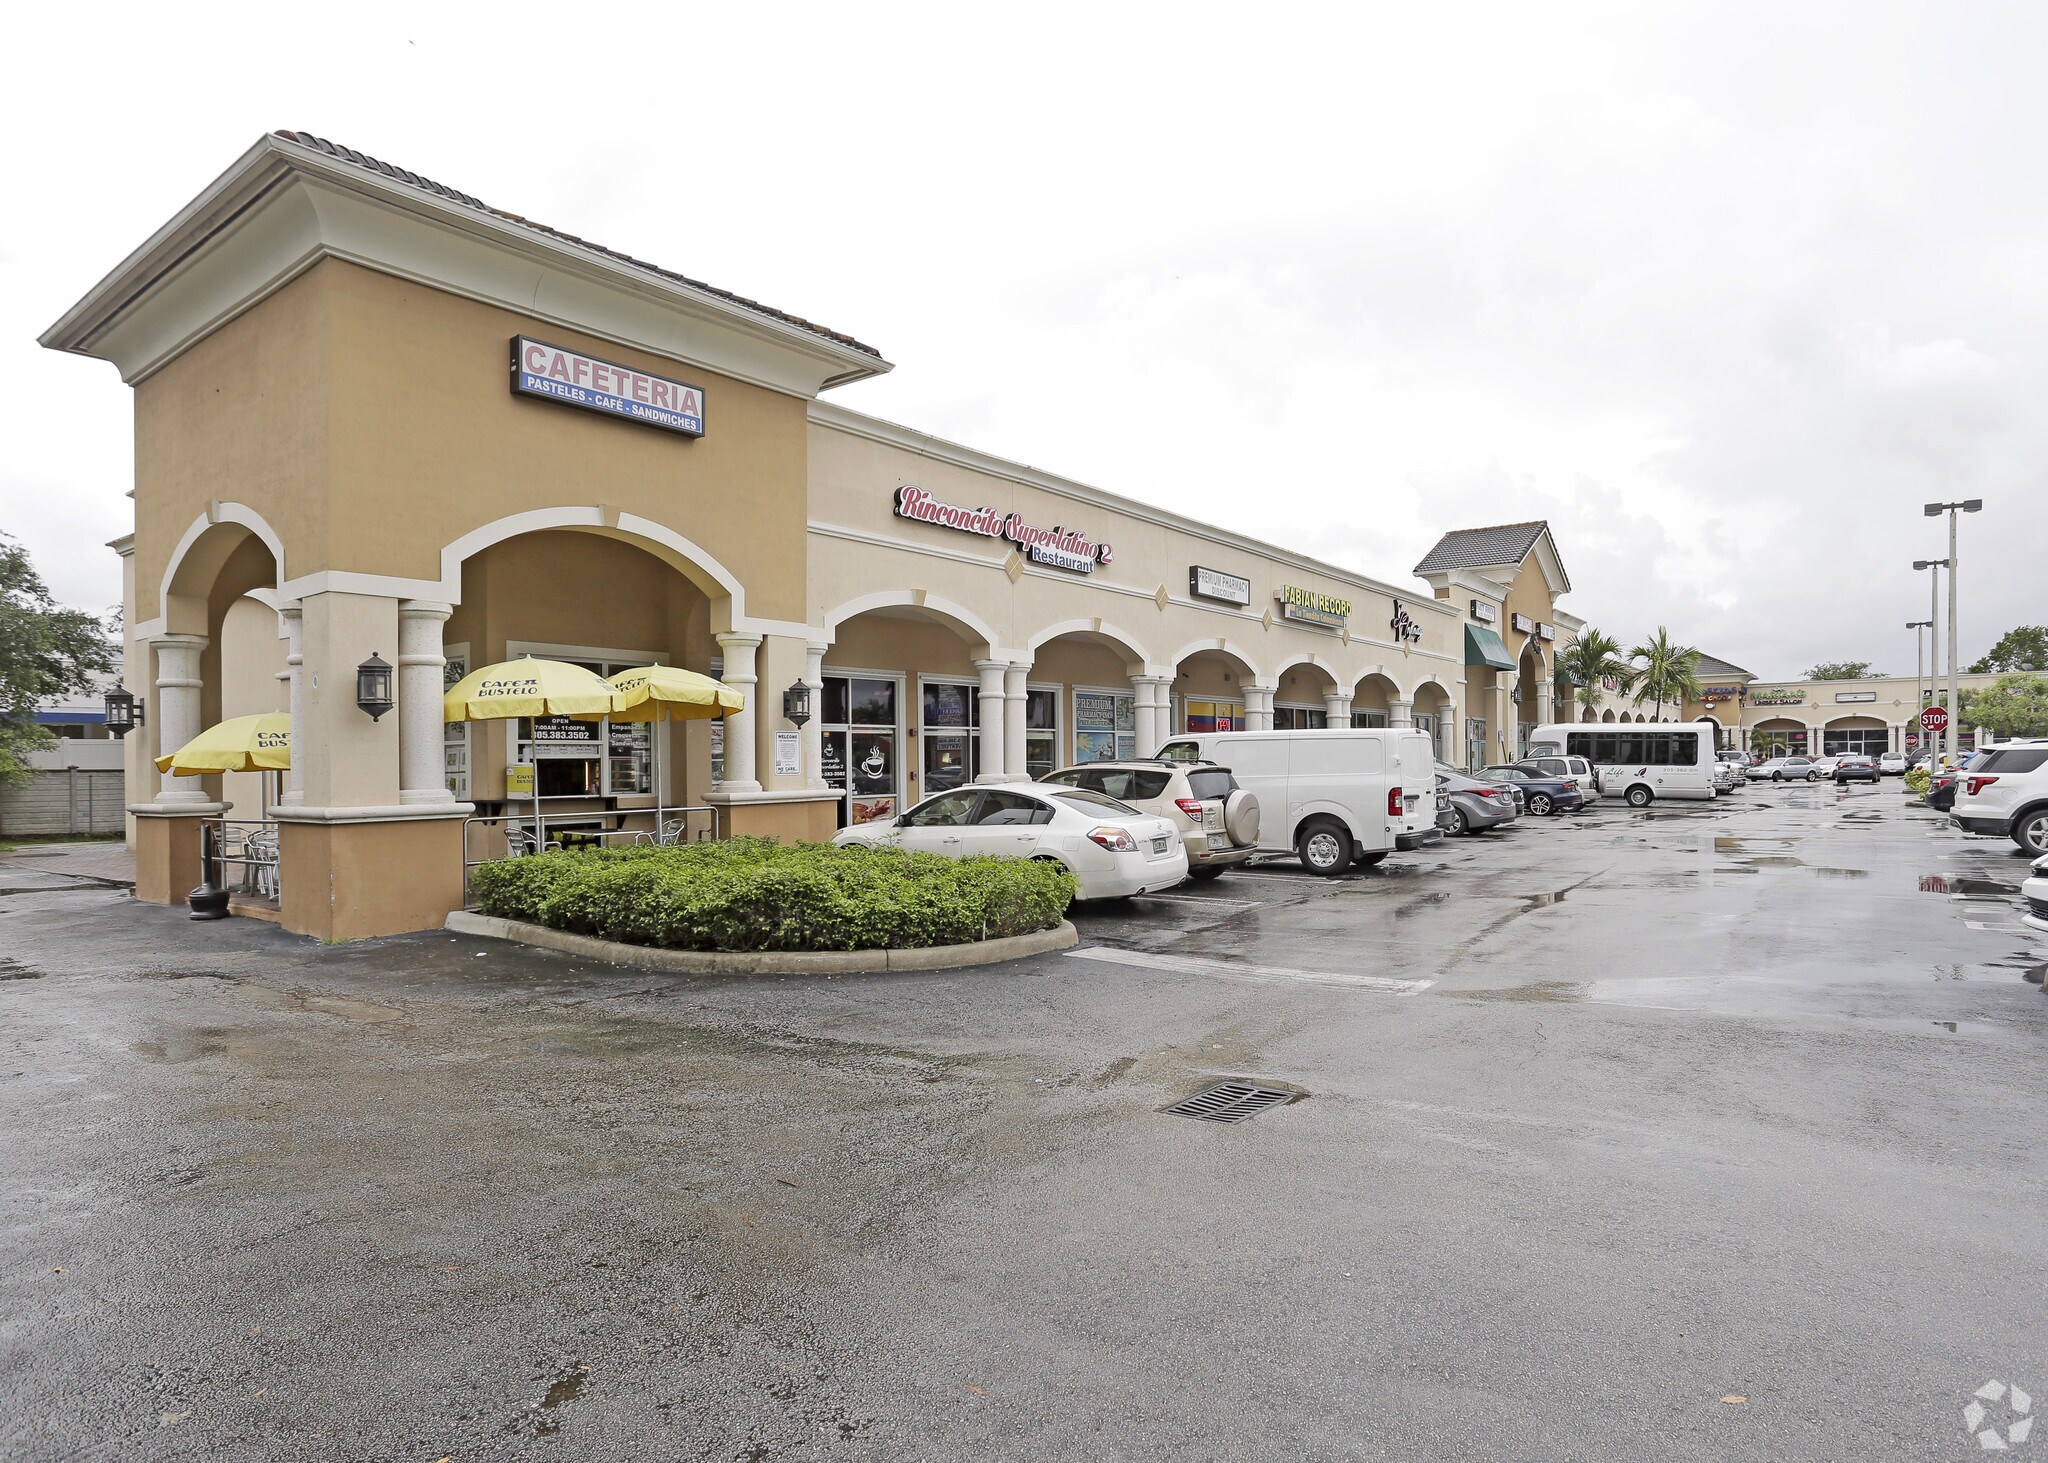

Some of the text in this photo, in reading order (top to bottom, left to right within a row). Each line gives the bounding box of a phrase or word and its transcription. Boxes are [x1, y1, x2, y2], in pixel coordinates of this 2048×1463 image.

[525, 345, 700, 417] CAFETERIA
[527, 377, 586, 401] PASTELES
[595, 395, 623, 412] CAFÉ
[632, 404, 697, 430] SANDWICHES
[902, 487, 1113, 563] Rinconcito Superlatino 2
[1034, 547, 1094, 572] Restaurant
[1199, 570, 1248, 594] PREMIUM PHARMACY
[1211, 586, 1236, 600] DISCOUNT
[1284, 585, 1352, 617] FABIAN RECORD
[478, 687, 538, 697] BUSTELO
[1077, 699, 1112, 710] PREMIUM
[1922, 714, 1948, 724] STOP
[1607, 767, 1625, 777] Life
